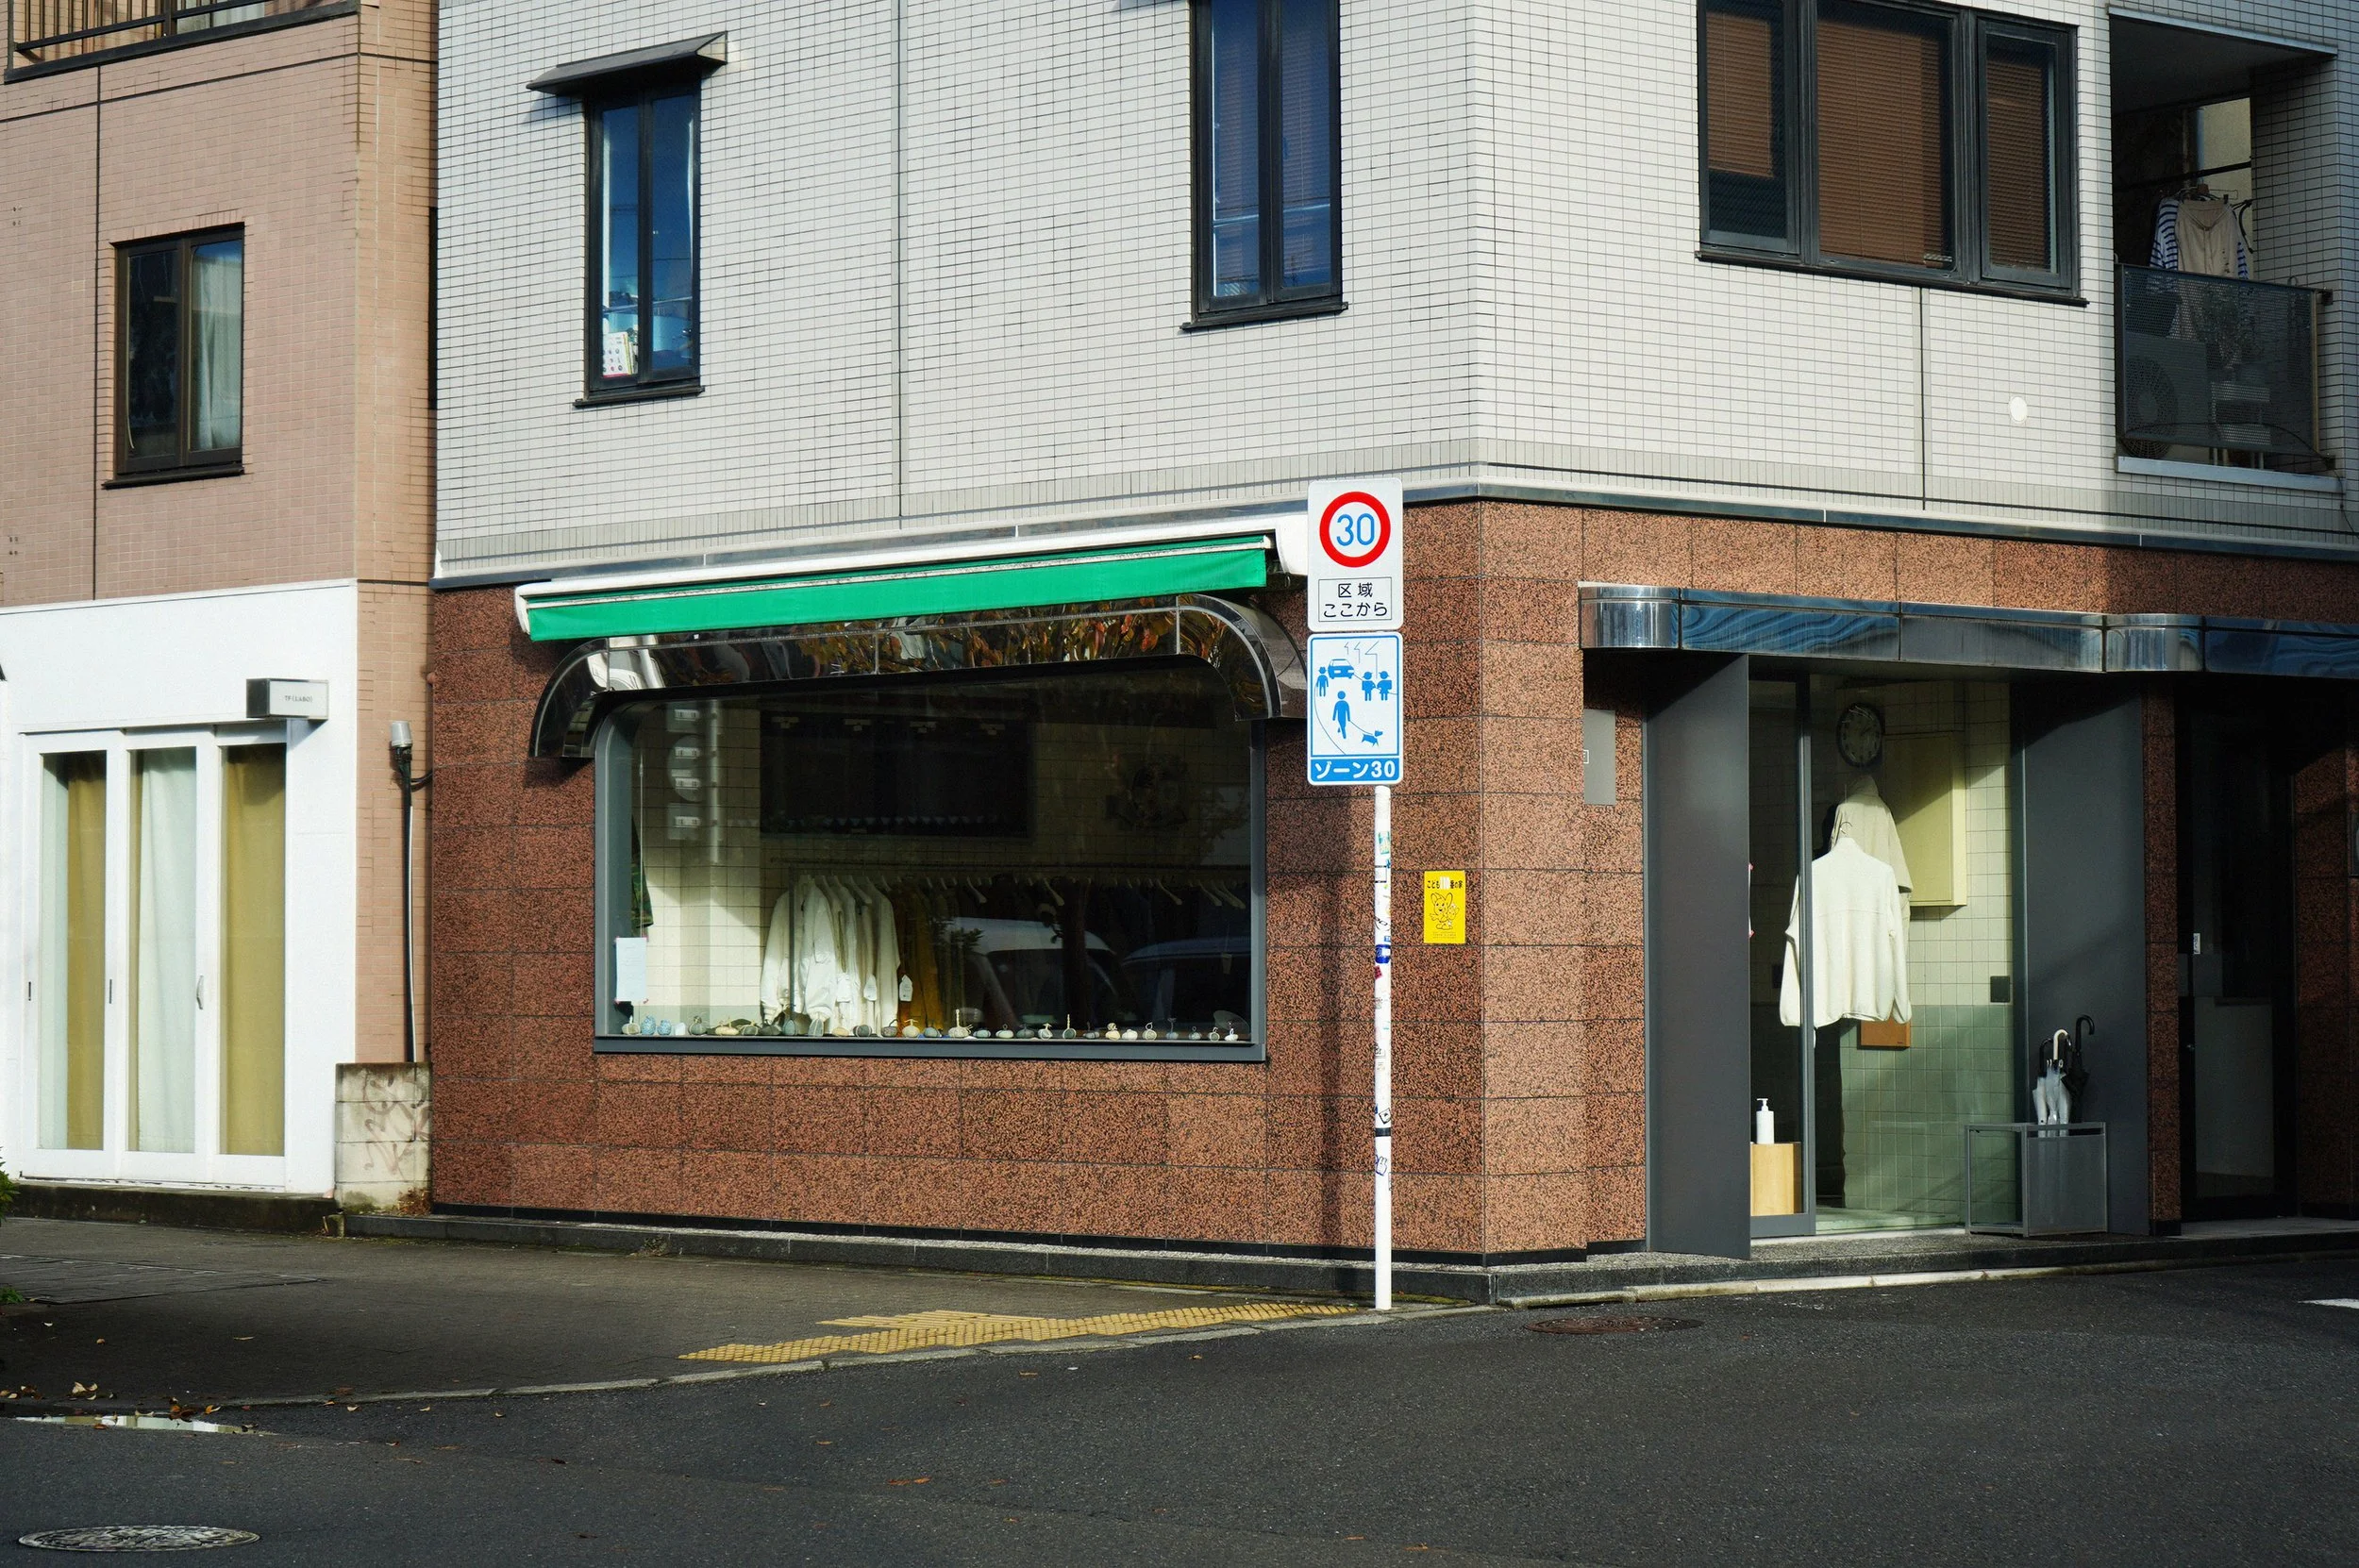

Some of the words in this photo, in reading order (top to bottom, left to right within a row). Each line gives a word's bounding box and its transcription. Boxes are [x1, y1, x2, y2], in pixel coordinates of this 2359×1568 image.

[1336, 512, 1375, 547] 30
[1338, 582, 1373, 598] 区域
[1324, 602, 1388, 617] ここから
[1314, 761, 1396, 780] ゾーン30
